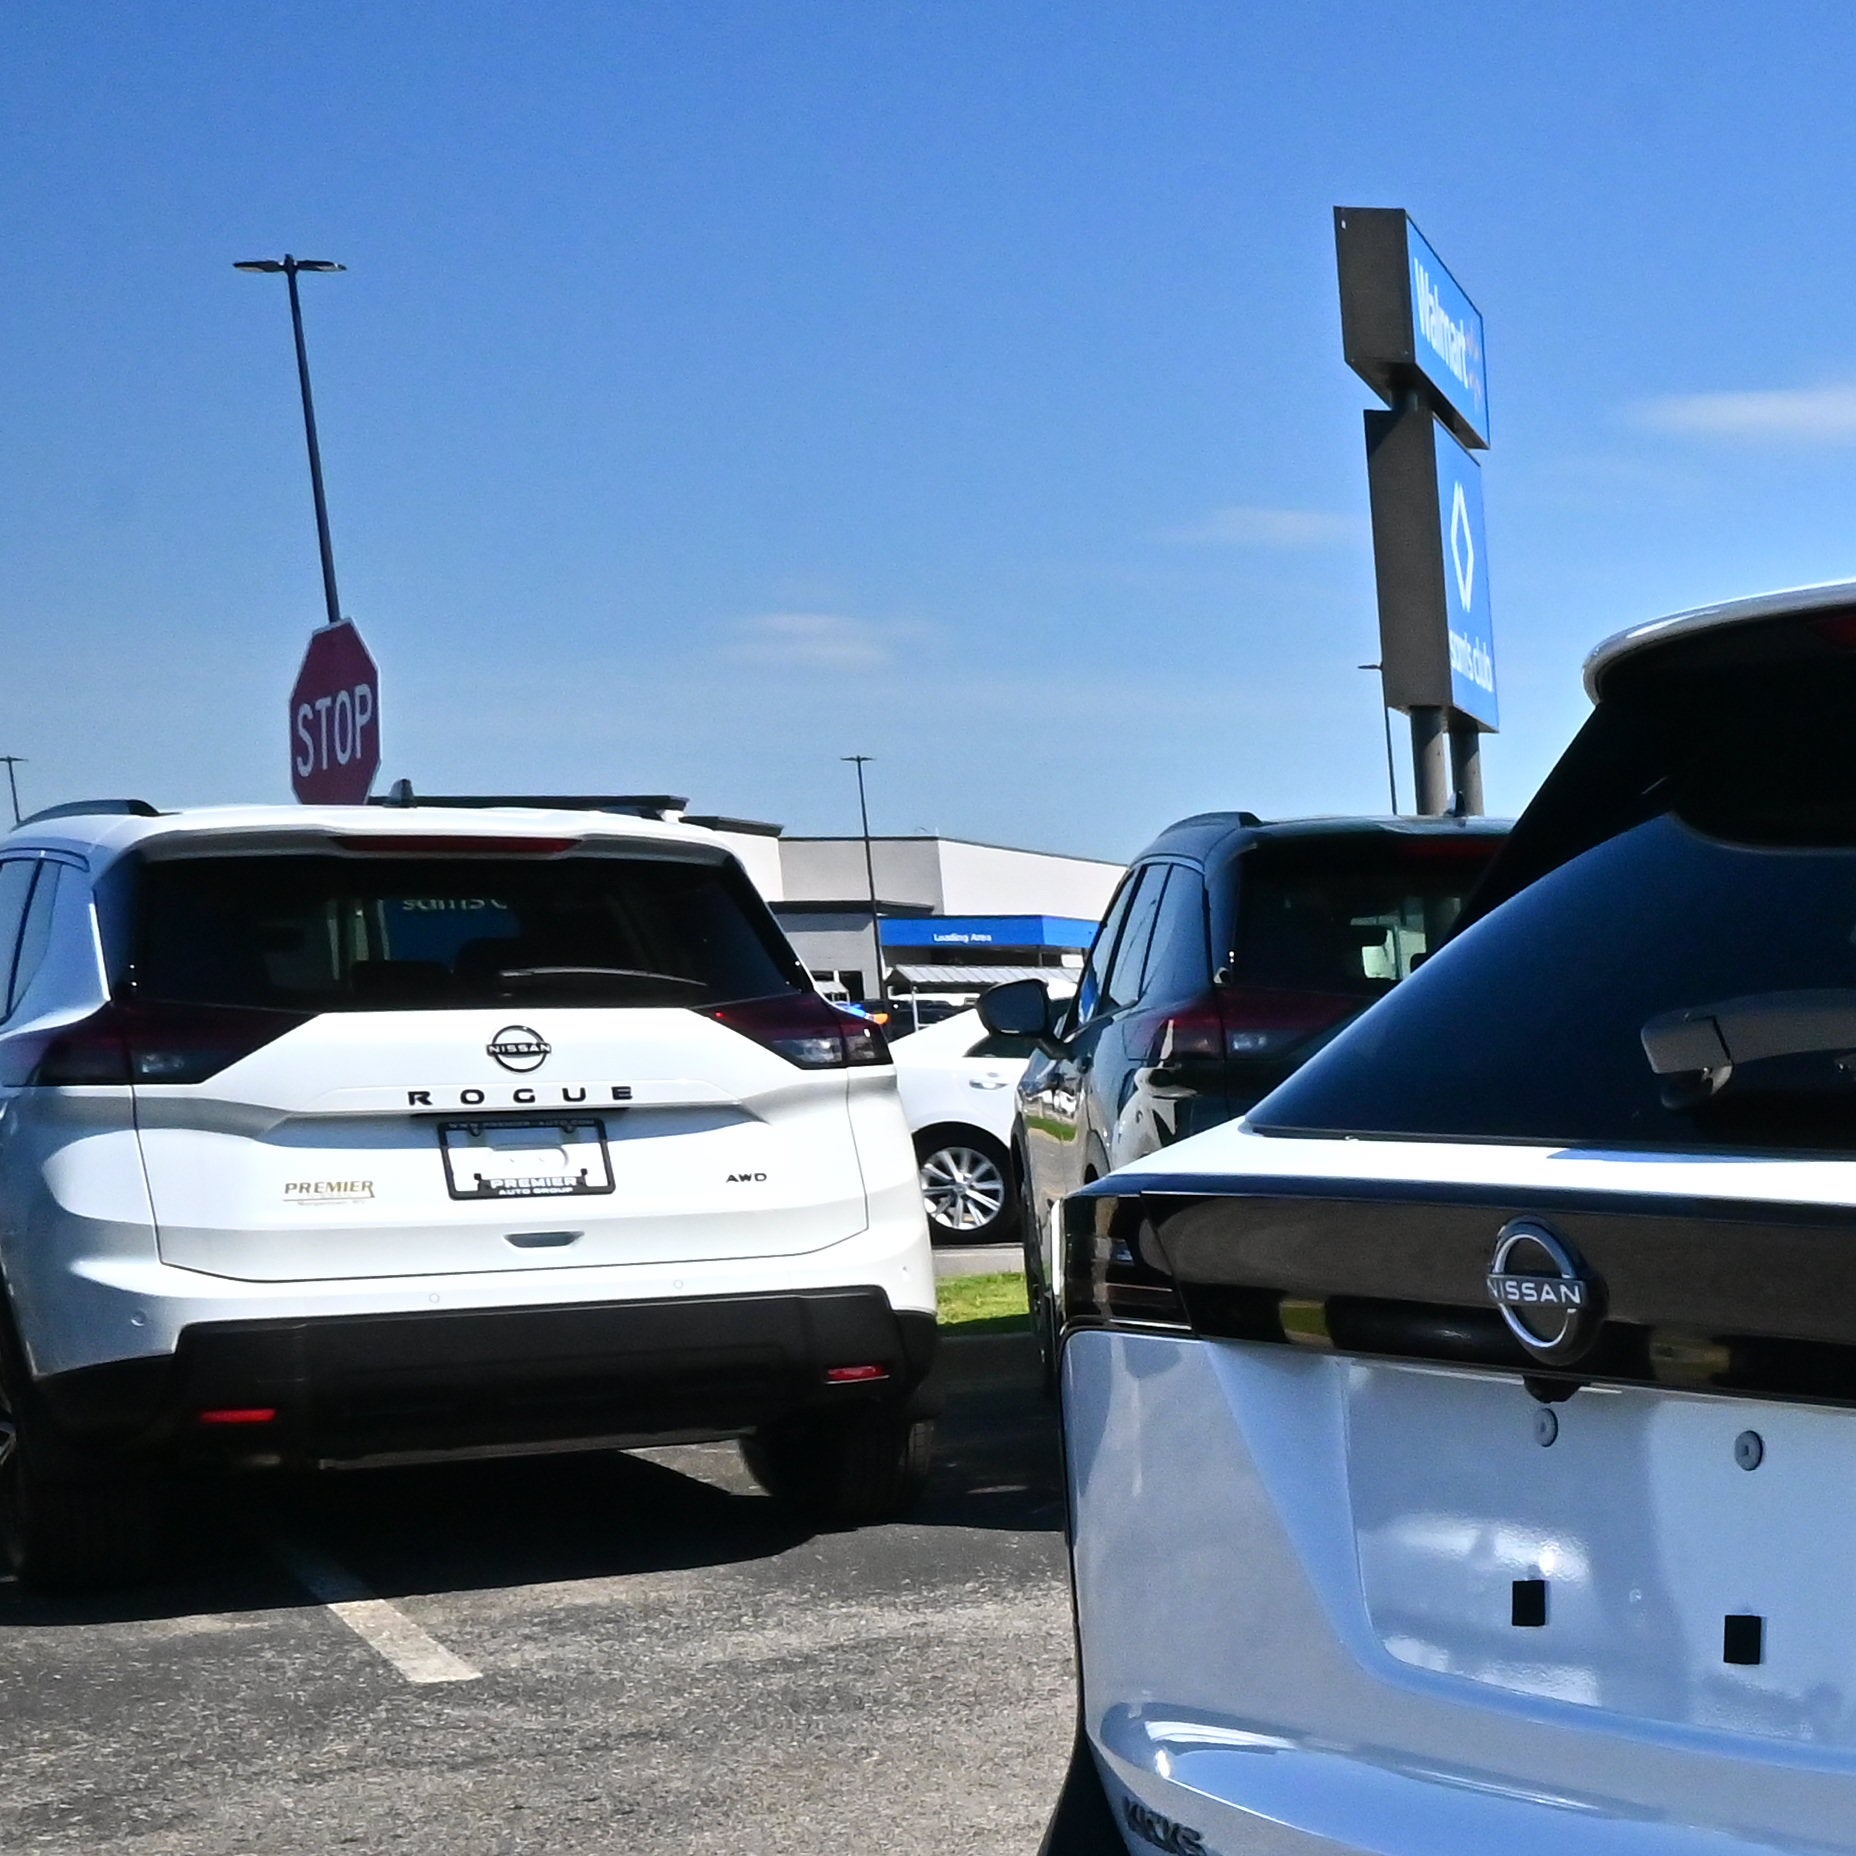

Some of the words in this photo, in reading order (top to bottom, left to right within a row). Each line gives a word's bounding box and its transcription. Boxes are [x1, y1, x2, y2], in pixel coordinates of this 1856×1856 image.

[1413, 257, 1469, 389] Walmart
[296, 683, 373, 777] STOP
[490, 1043, 551, 1055] NISSAN
[407, 1086, 634, 1106] ROGUE
[490, 1176, 577, 1190] PREMIER
[725, 1172, 768, 1184] AWD
[284, 1180, 375, 1199] PREMIER
[1486, 1278, 1582, 1305] NISSAN
